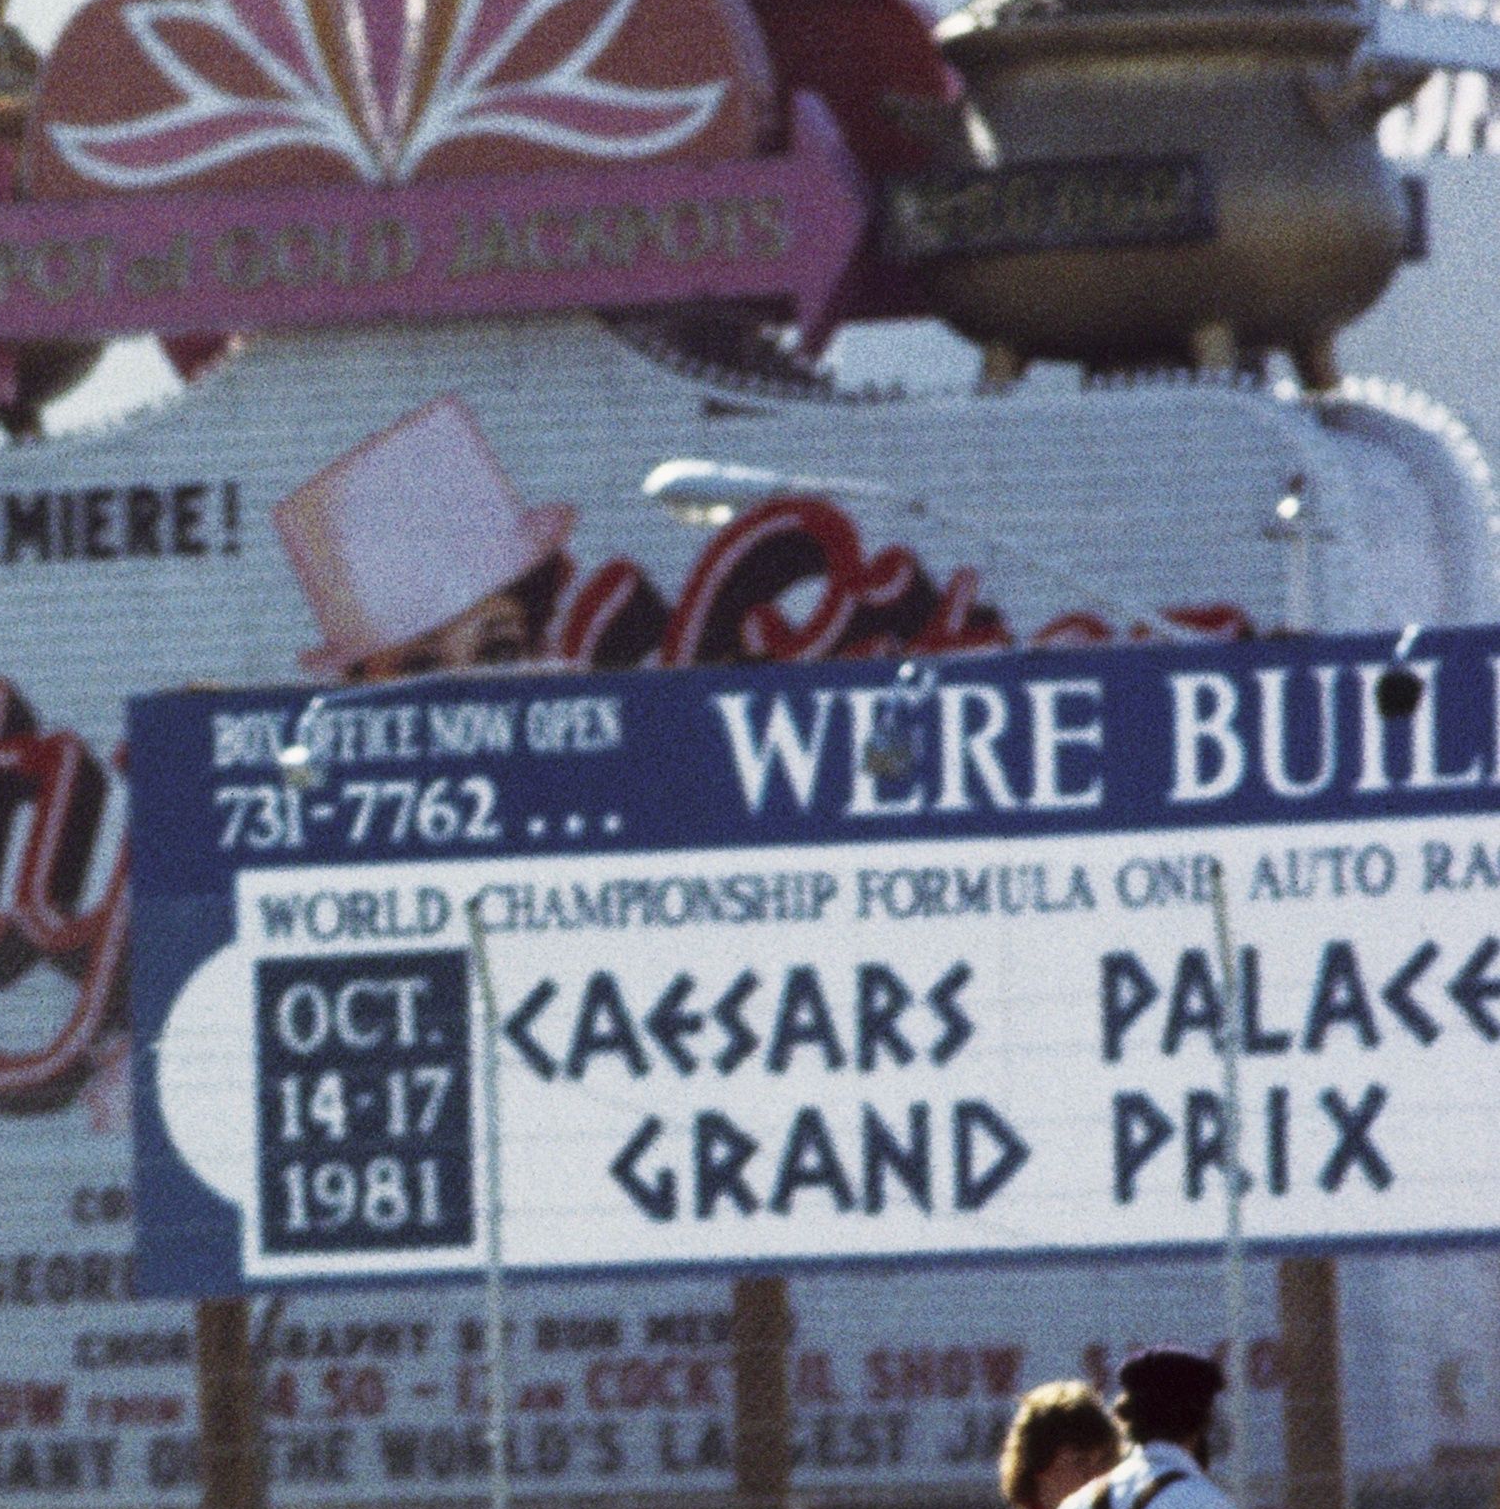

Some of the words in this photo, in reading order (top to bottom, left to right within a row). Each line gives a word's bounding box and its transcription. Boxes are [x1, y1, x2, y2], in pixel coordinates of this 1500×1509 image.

[212, 218, 418, 292] GOLD
[427, 698, 514, 754] NOW
[526, 695, 623, 753] OPEN
[1165, 655, 1500, 804] BUIL
[213, 774, 502, 850] 731-7762
[258, 888, 452, 942] WORLD
[478, 870, 838, 935] CHAMPIONSHIP
[854, 860, 1098, 920] FORMULA
[1115, 852, 1220, 910] ONE
[1249, 842, 1396, 902] AUTO
[276, 978, 445, 1056] OCT.
[503, 958, 975, 1082] CAESARS
[1100, 935, 1500, 1065] PALACE
[280, 1066, 455, 1144] 14-17
[610, 1096, 1033, 1223] GRAND
[1112, 1083, 1396, 1205] PRIX
[280, 1156, 442, 1237] 1981
[865, 1343, 1022, 1406] SHOW
